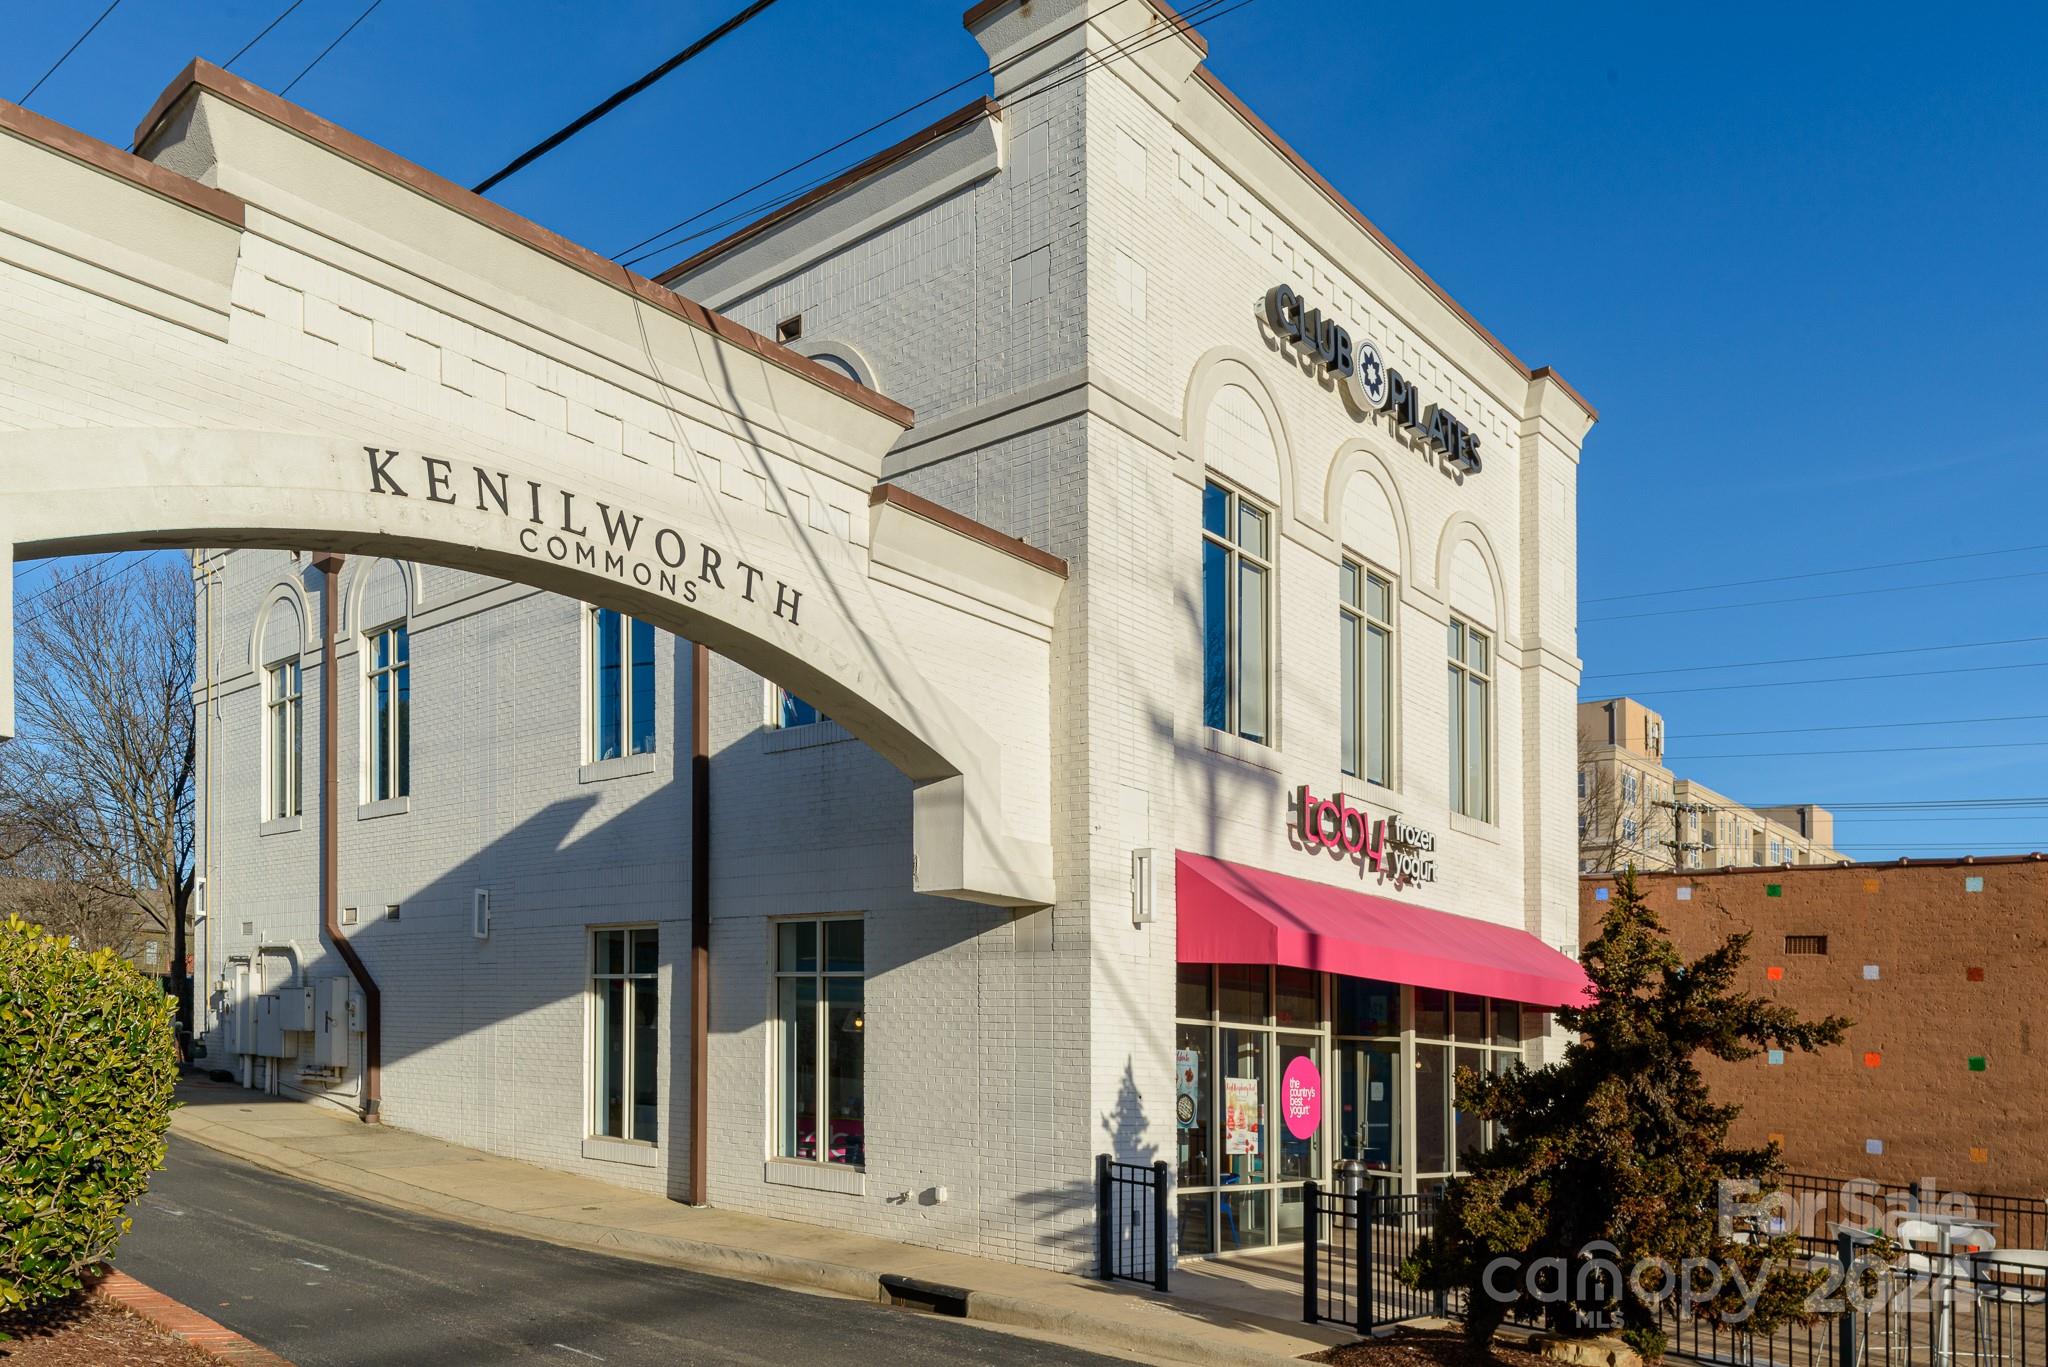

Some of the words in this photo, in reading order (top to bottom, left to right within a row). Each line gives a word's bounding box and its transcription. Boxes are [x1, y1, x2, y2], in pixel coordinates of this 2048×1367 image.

[1267, 284, 1354, 379] CLUB
[1385, 368, 1482, 474] PILATES
[363, 446, 803, 626] KENILWORTH
[519, 528, 697, 603] COMMONS
[1300, 785, 1385, 871] tcby
[1395, 816, 1436, 851] frozen
[1394, 849, 1438, 882] yogurt
[1289, 1077, 1300, 1089] the
[1289, 1087, 1316, 1101] country's
[1289, 1096, 1304, 1106] best
[1289, 1105, 1310, 1118] yogurt
